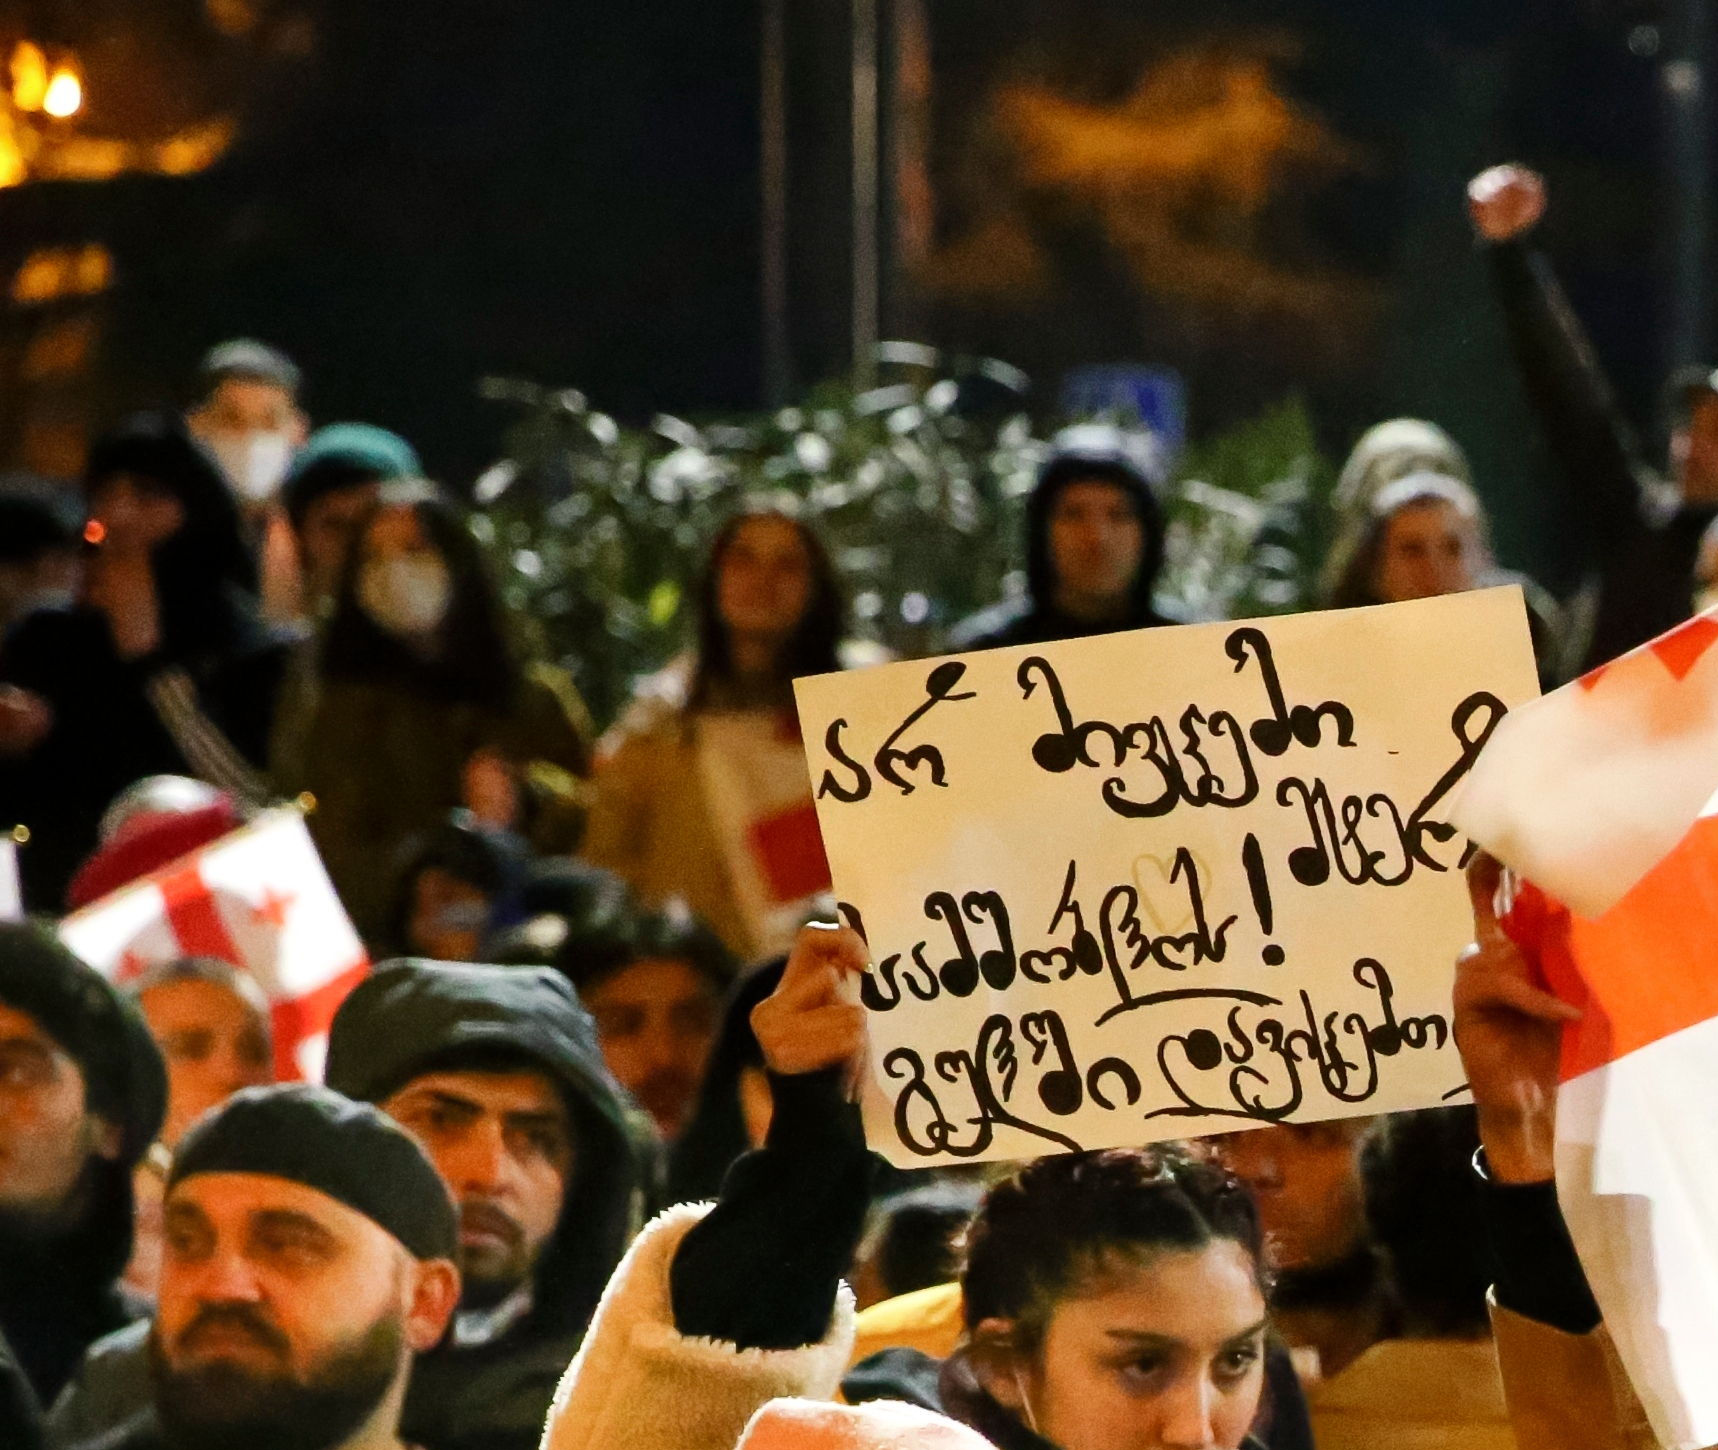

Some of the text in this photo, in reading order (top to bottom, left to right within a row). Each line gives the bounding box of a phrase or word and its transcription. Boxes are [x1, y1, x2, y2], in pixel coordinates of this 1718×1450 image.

[817, 627, 1357, 818] არ მივცემთ
[1276, 691, 1509, 886] მტერ
[883, 1009, 1142, 1157] გულში
